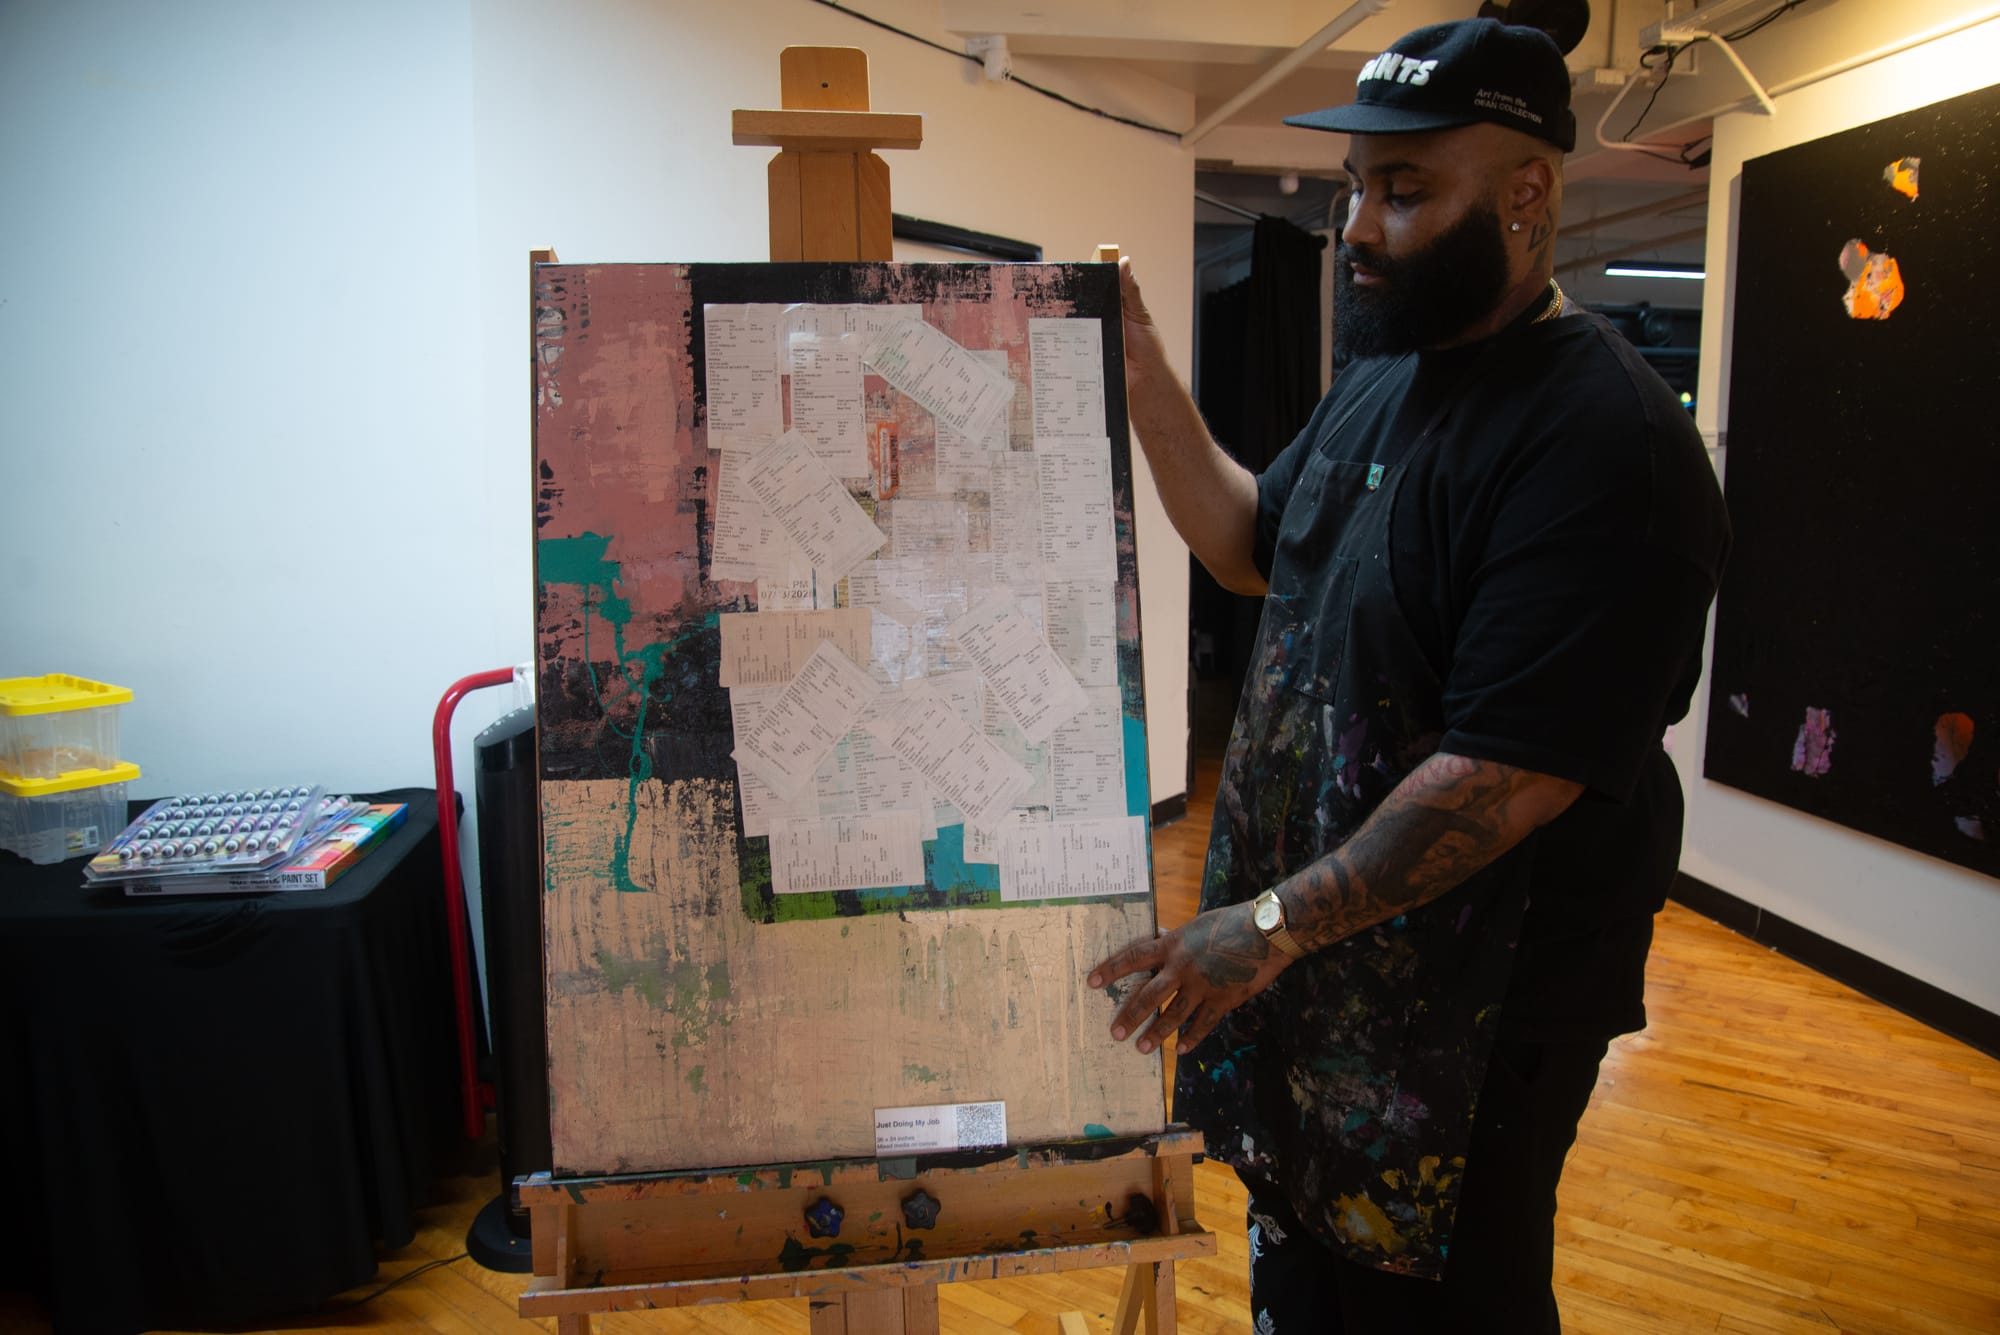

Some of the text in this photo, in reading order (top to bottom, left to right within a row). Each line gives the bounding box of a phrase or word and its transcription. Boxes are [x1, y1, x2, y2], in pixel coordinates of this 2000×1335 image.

[1356, 52, 1439, 87] ANTS
[1476, 88, 1527, 108] Art from the
[1474, 98, 1542, 124] DEAN COLLECTION
[281, 874, 302, 884] PAINT
[304, 873, 318, 883] SET
